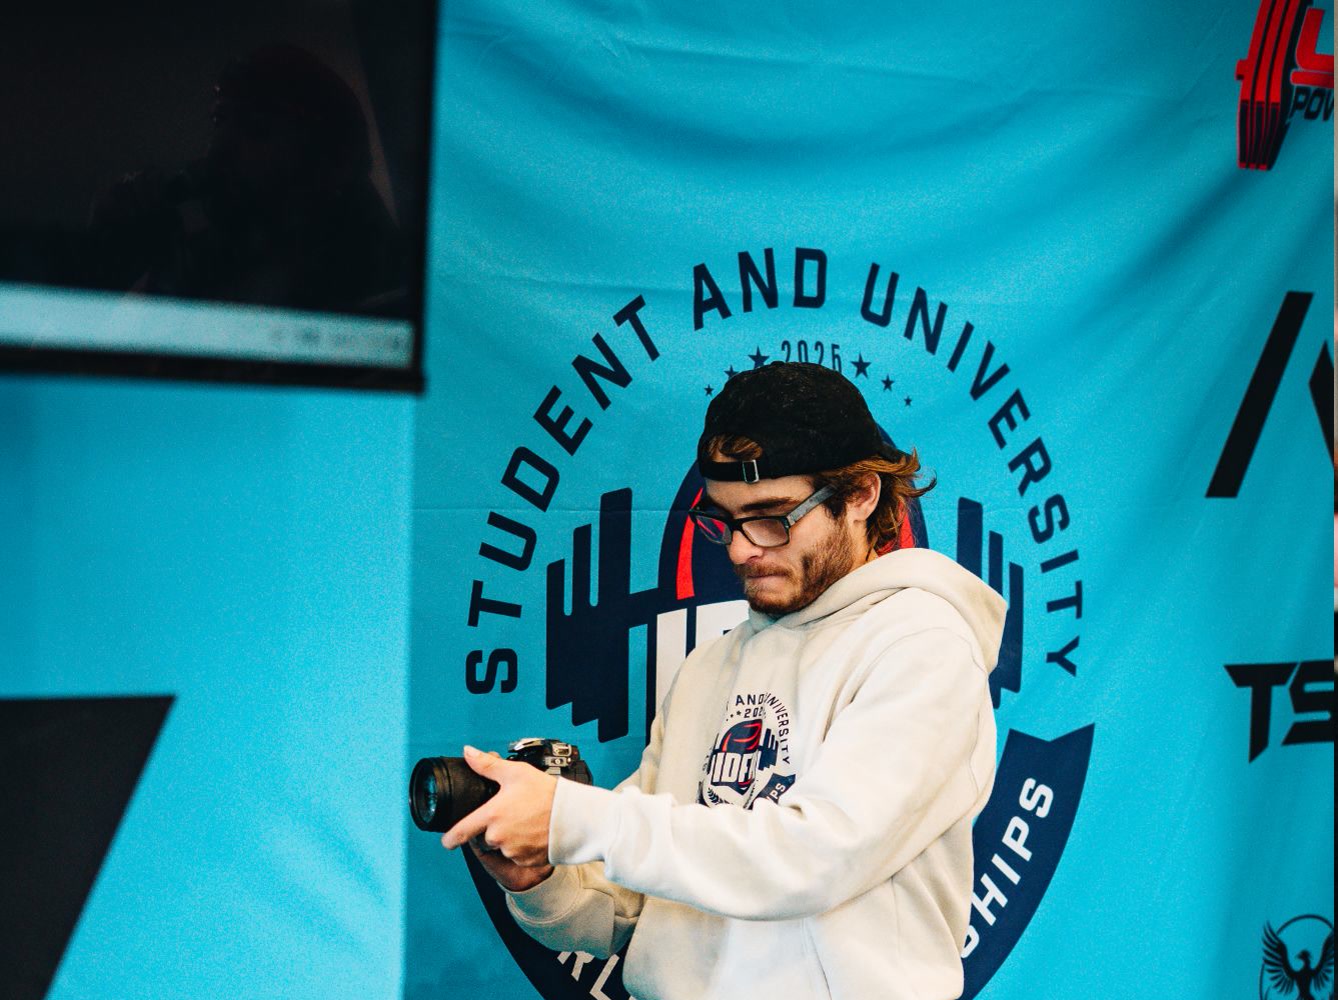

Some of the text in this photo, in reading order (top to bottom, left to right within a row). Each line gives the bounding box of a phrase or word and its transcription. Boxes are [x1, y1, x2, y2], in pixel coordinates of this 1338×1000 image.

[466, 247, 1083, 695] STUDENT AND UNIVERSITY
[744, 707, 766, 719] 202
